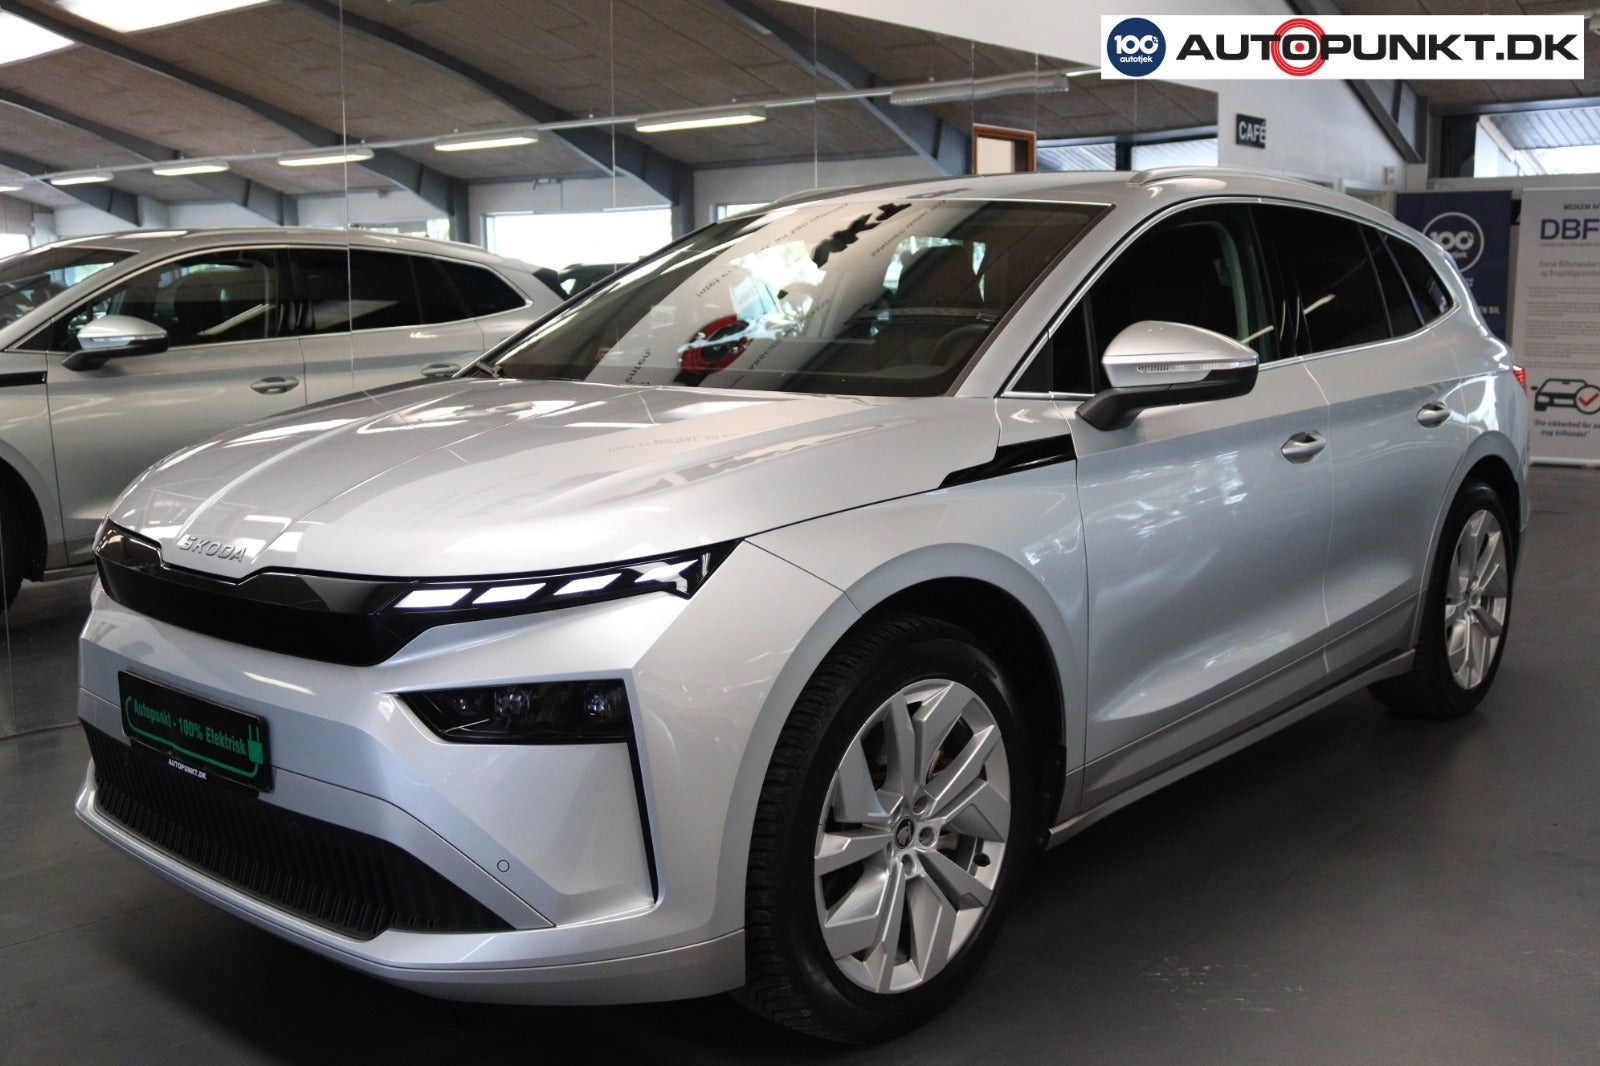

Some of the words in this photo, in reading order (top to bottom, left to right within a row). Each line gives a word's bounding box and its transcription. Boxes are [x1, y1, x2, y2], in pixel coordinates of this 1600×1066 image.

[1239, 121, 1266, 143] CAFÉ
[134, 699, 172, 728] Autopunkt
[178, 717, 204, 740] 100%
[205, 726, 247, 755] Elektrisk
[168, 758, 207, 780] AUTOPUNKT.DK
